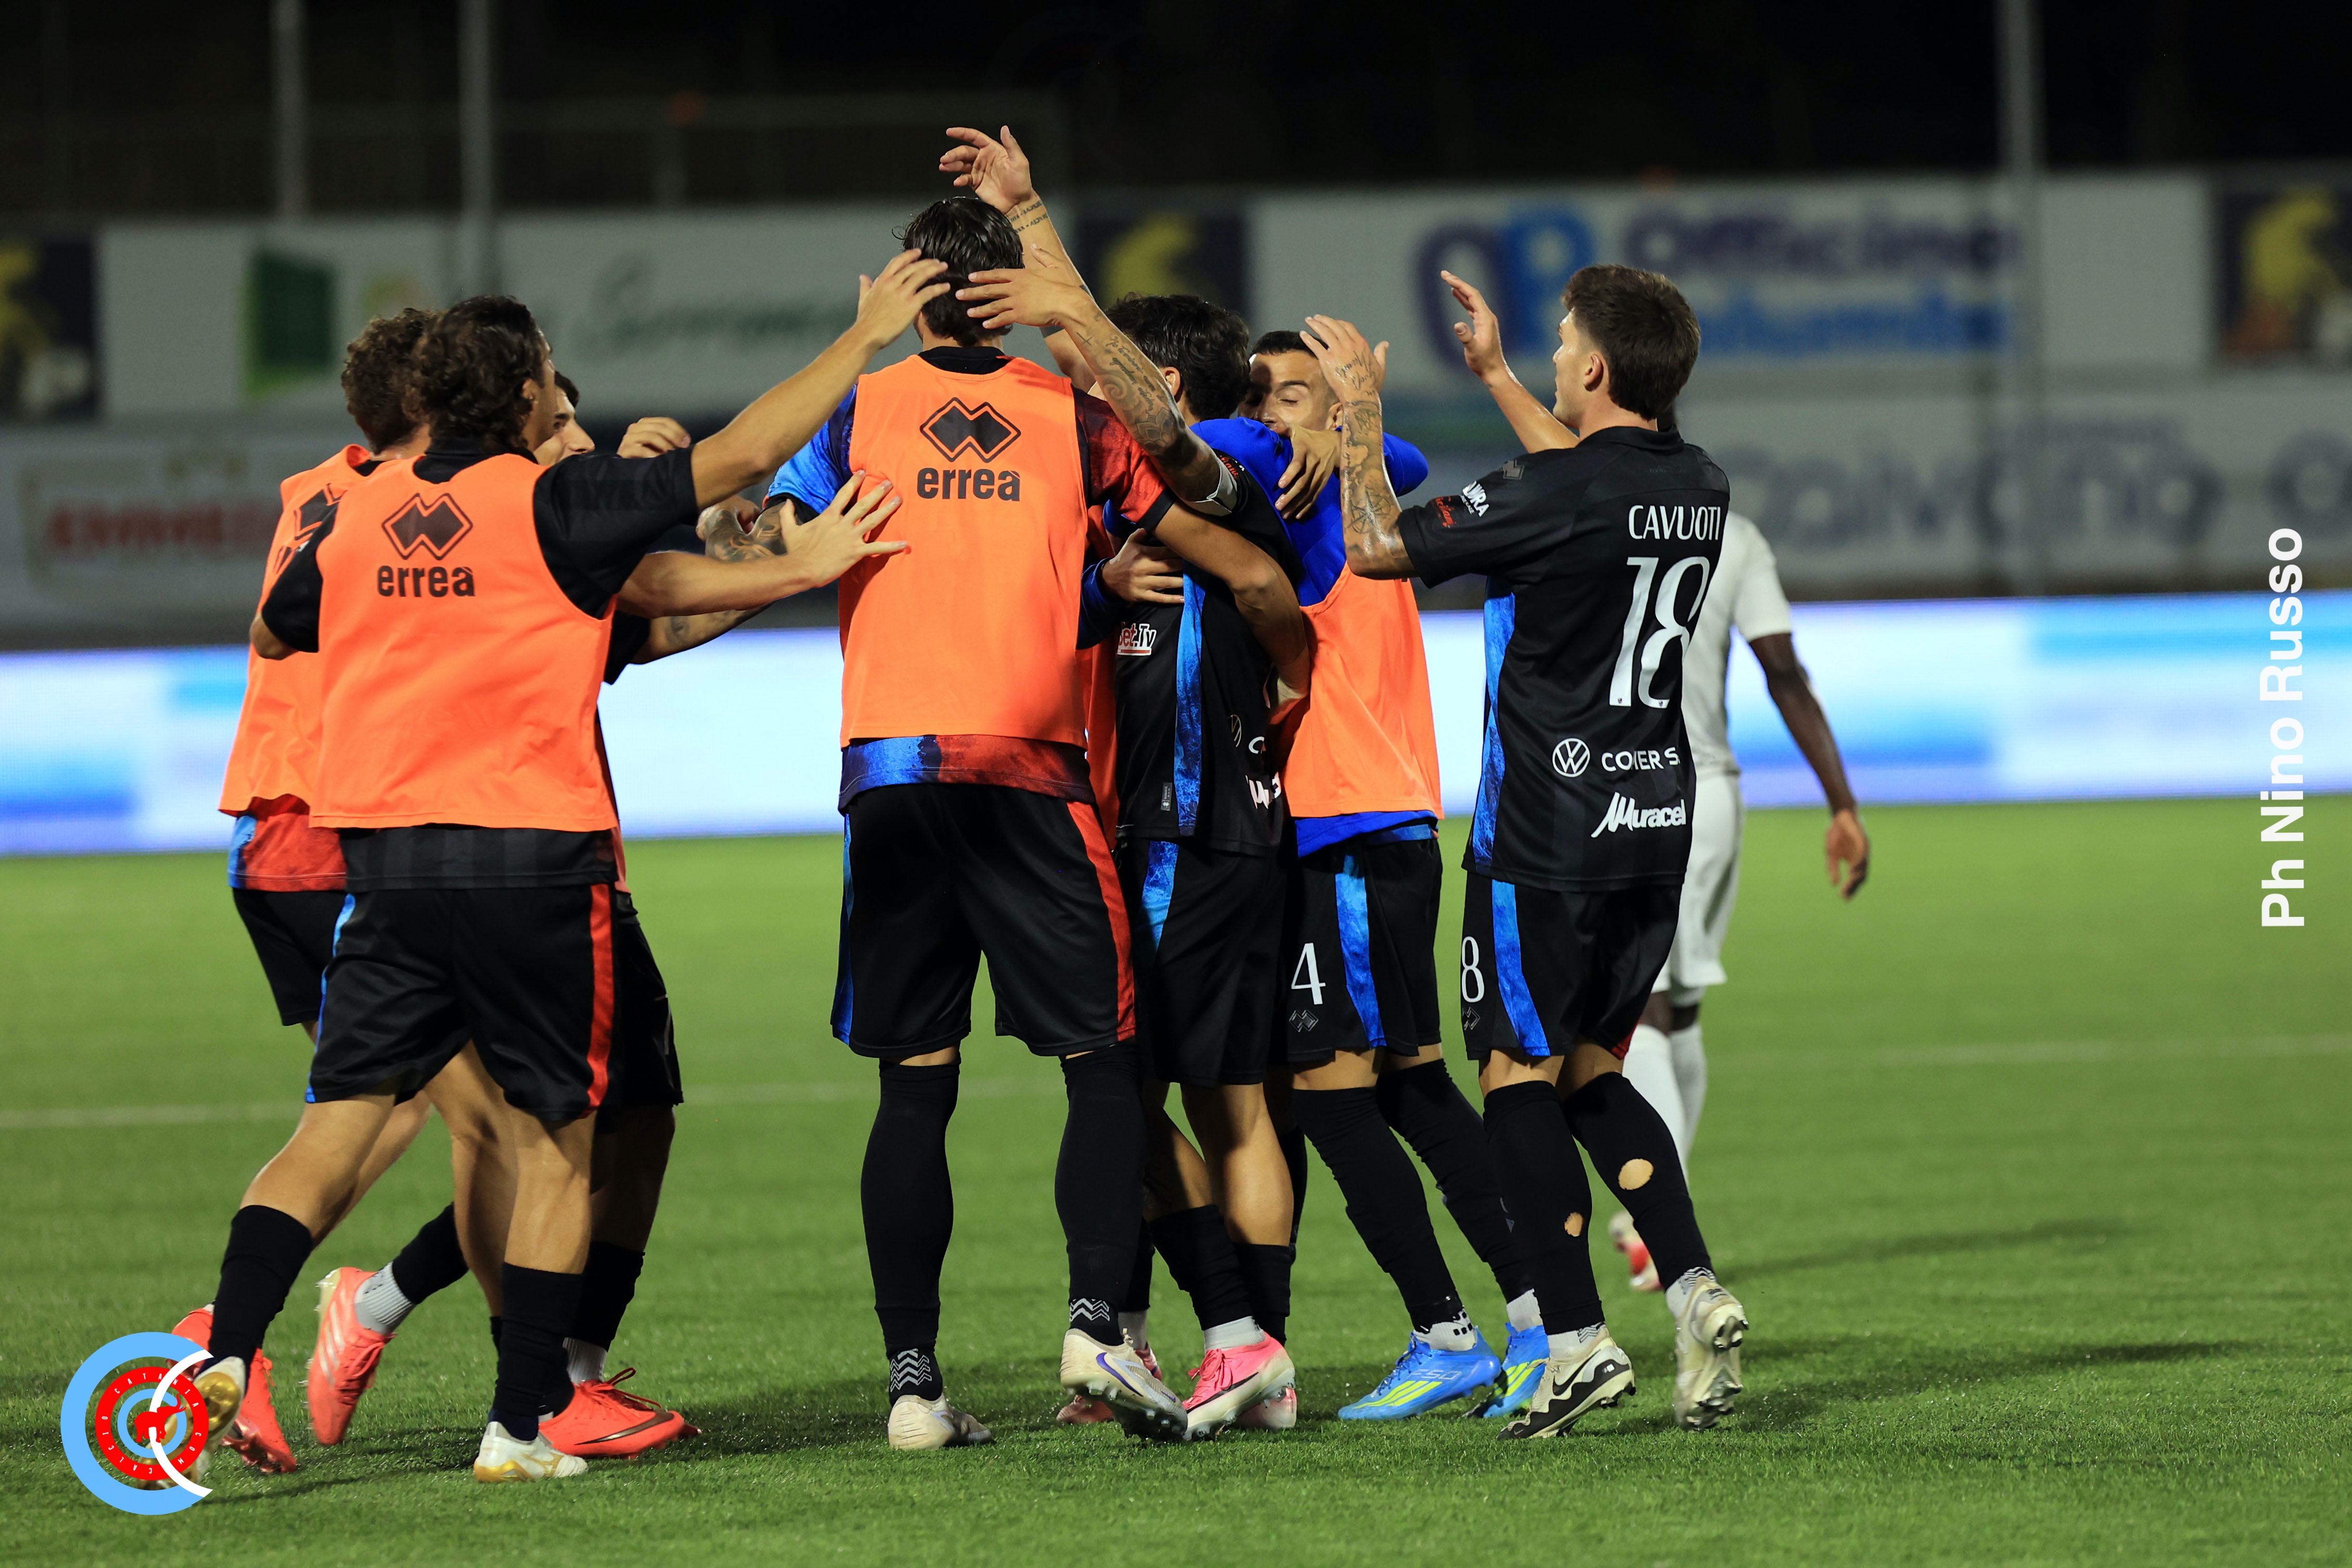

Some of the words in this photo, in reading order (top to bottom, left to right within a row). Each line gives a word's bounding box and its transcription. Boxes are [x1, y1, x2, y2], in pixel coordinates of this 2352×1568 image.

[1628, 505, 1721, 541] CAVUOTI
[1609, 556, 1710, 708] 18
[1291, 942, 1326, 1005] 4
